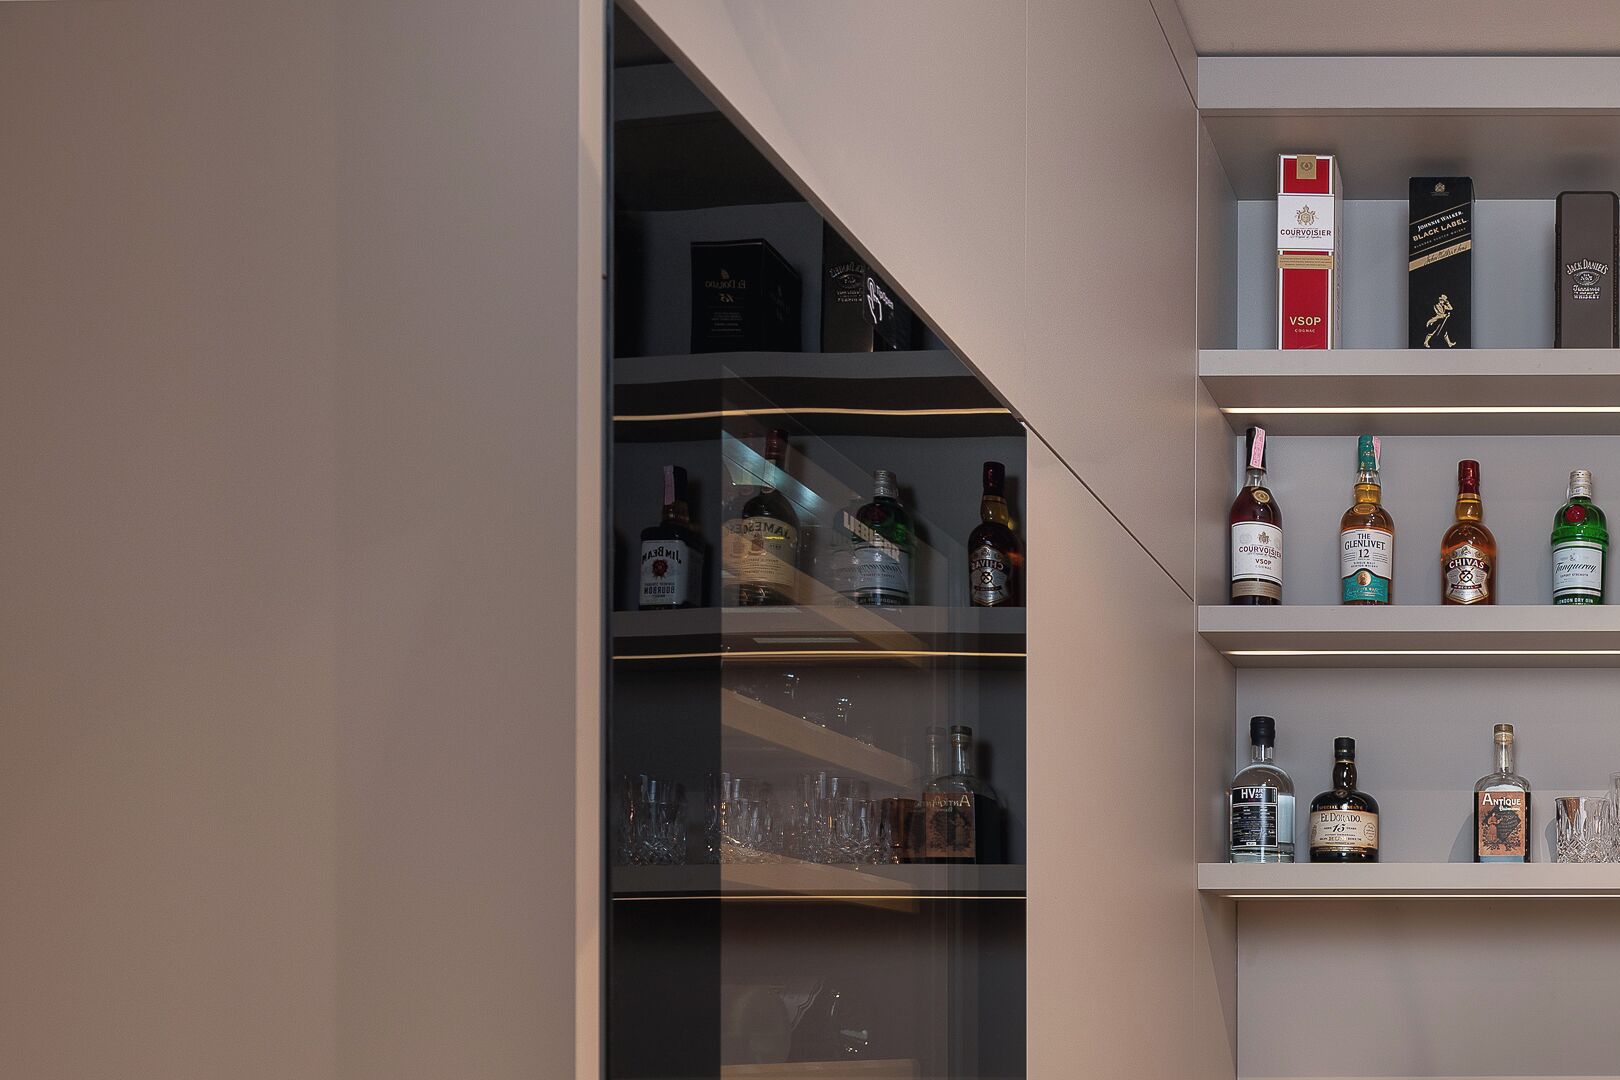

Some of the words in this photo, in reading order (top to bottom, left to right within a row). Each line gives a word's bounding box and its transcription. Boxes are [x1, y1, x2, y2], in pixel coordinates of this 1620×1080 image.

[1417, 218, 1440, 232] JOHNNIE
[1440, 210, 1463, 223] WALKER
[1280, 229, 1332, 237] COURVOISIER
[1412, 227, 1439, 242] BLACK
[1441, 218, 1468, 231] LABEL
[1566, 260, 1583, 275] JACK
[1583, 259, 1609, 275] DANIEL'S
[1289, 316, 1321, 326] VSOP
[1344, 540, 1386, 551] GLENLIVET
[1358, 548, 1369, 558] 12
[1255, 558, 1272, 566] VSOP
[1449, 558, 1484, 569] CHIVAS
[1555, 562, 1598, 574] Tanqueray
[1241, 788, 1255, 799] HV
[1482, 793, 1522, 806] ANTIQUE
[1320, 813, 1330, 823] EL
[1332, 823, 1346, 833] 15
